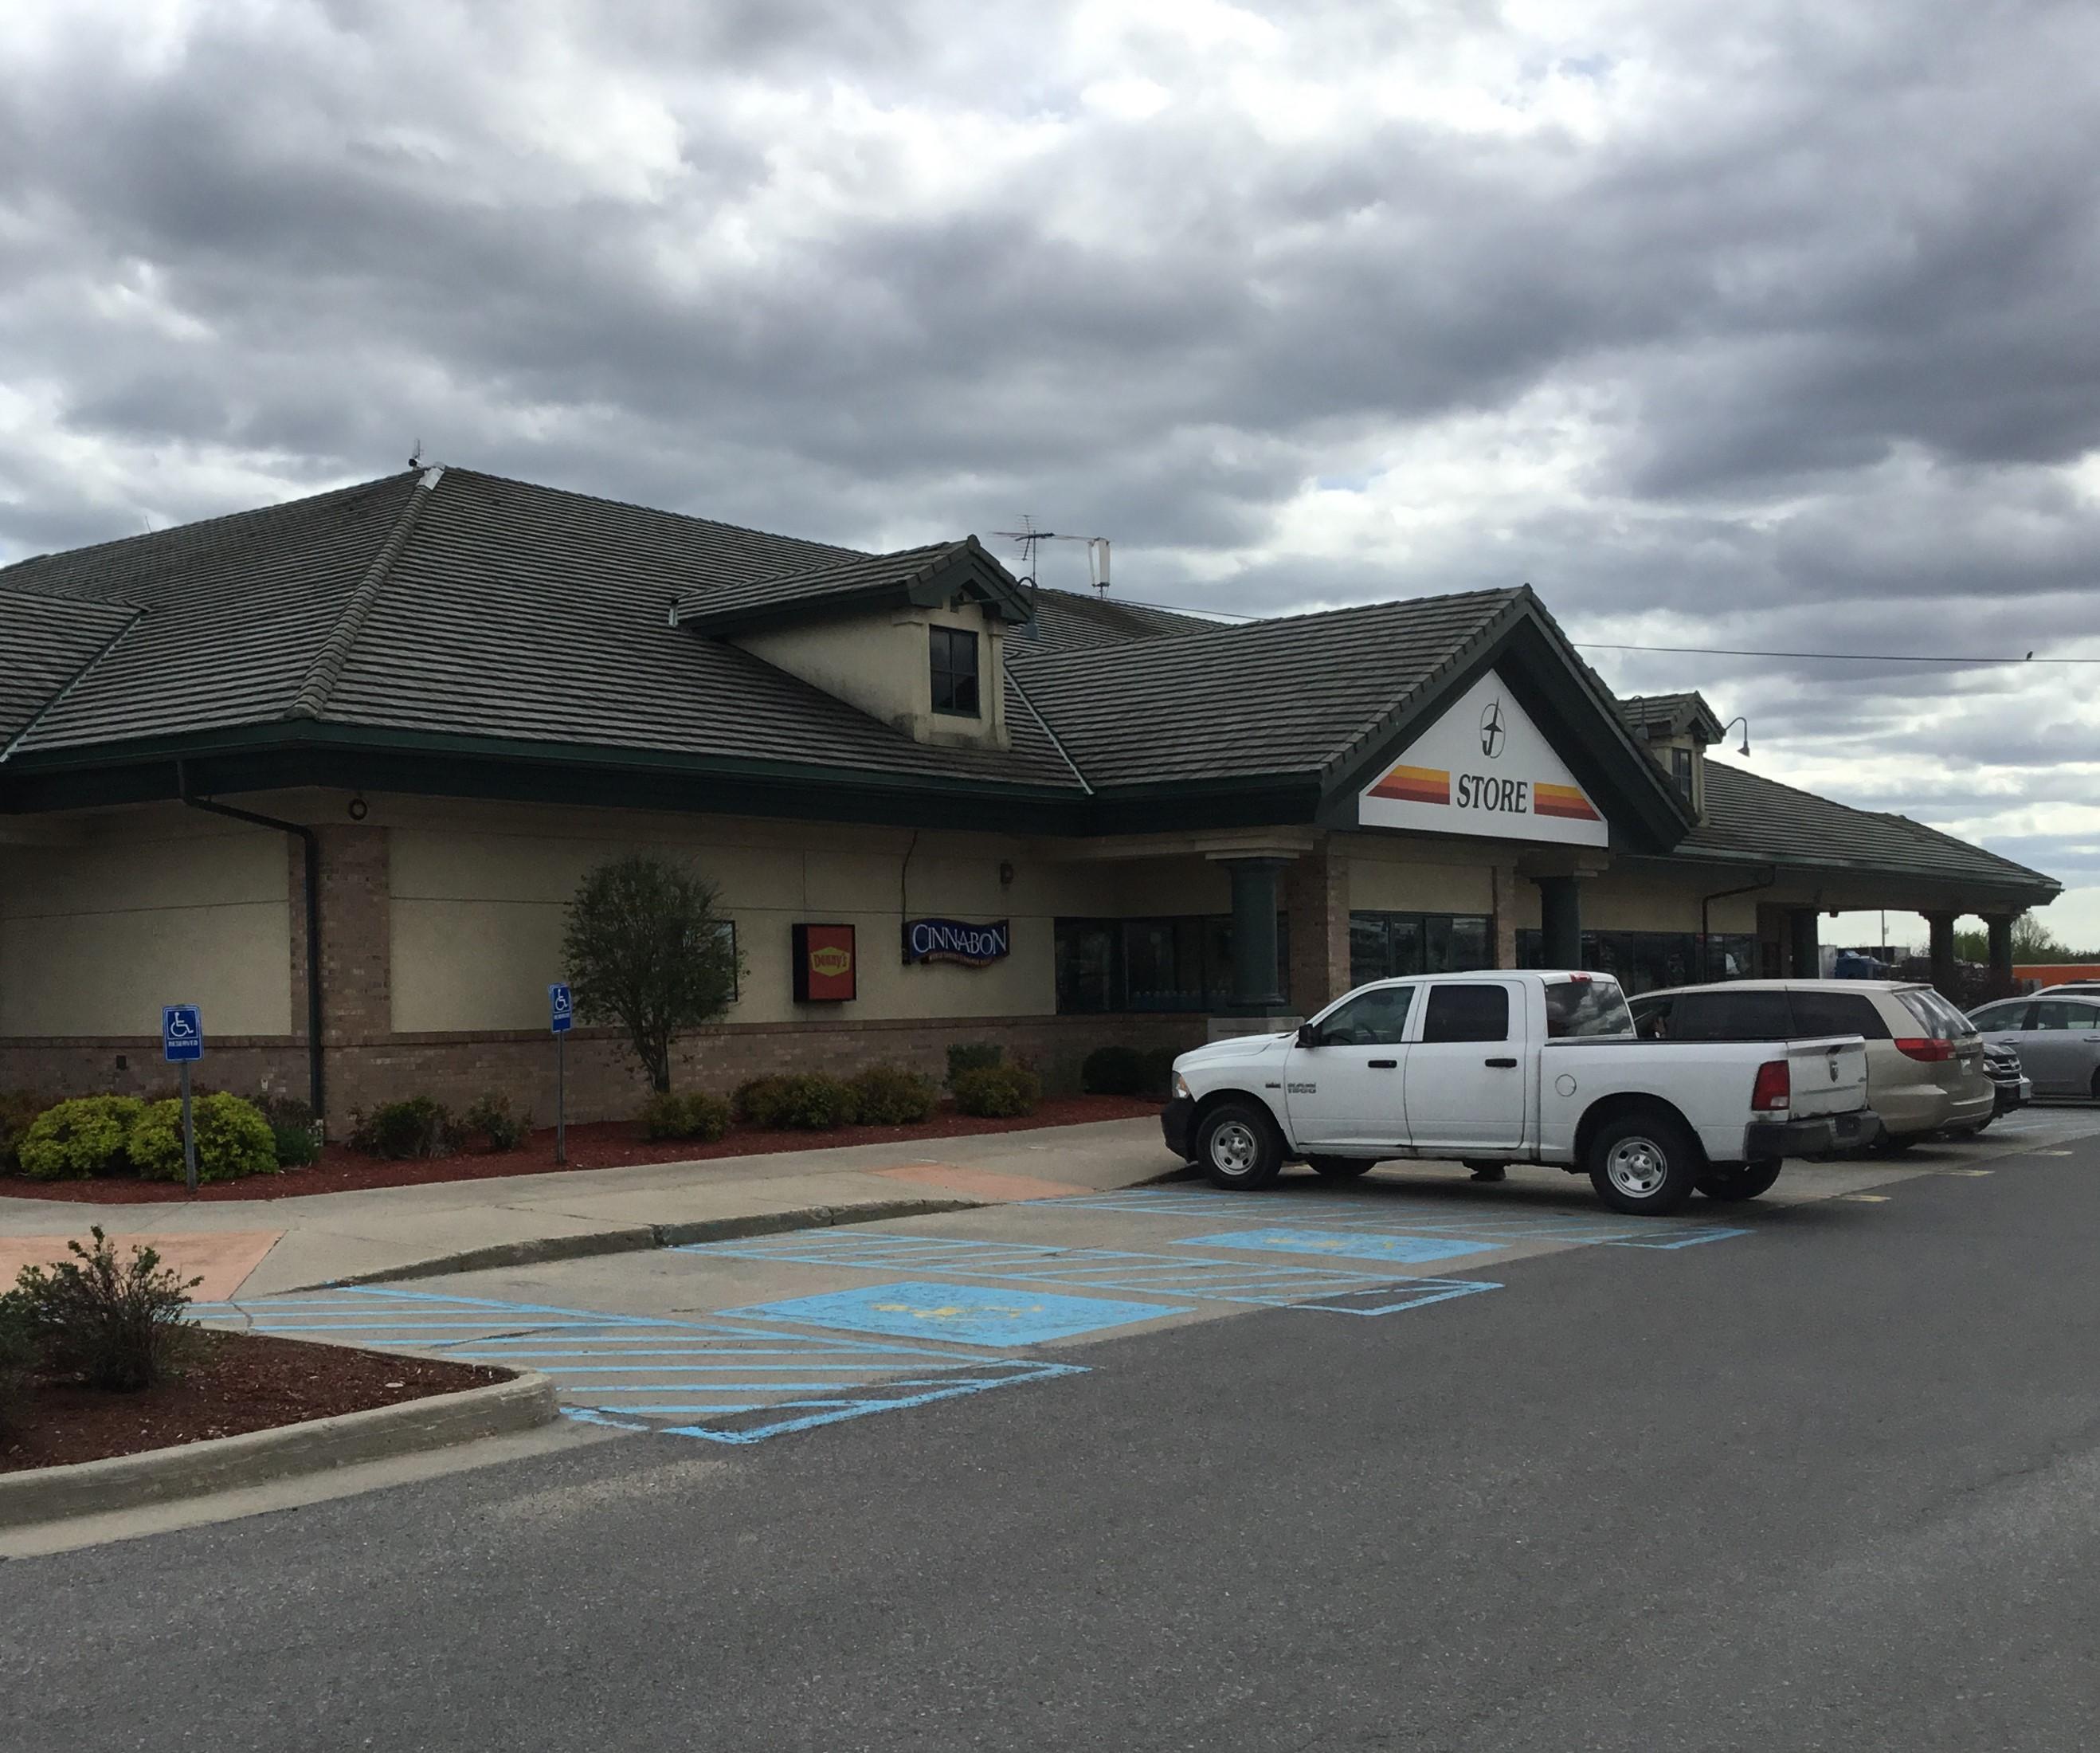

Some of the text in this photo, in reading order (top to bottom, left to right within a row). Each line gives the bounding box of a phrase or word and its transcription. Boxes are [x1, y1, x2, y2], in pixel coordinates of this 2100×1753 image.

[1456, 773, 1528, 814] STORE
[912, 924, 1007, 955] CINNABON
[813, 953, 848, 970] Denny's
